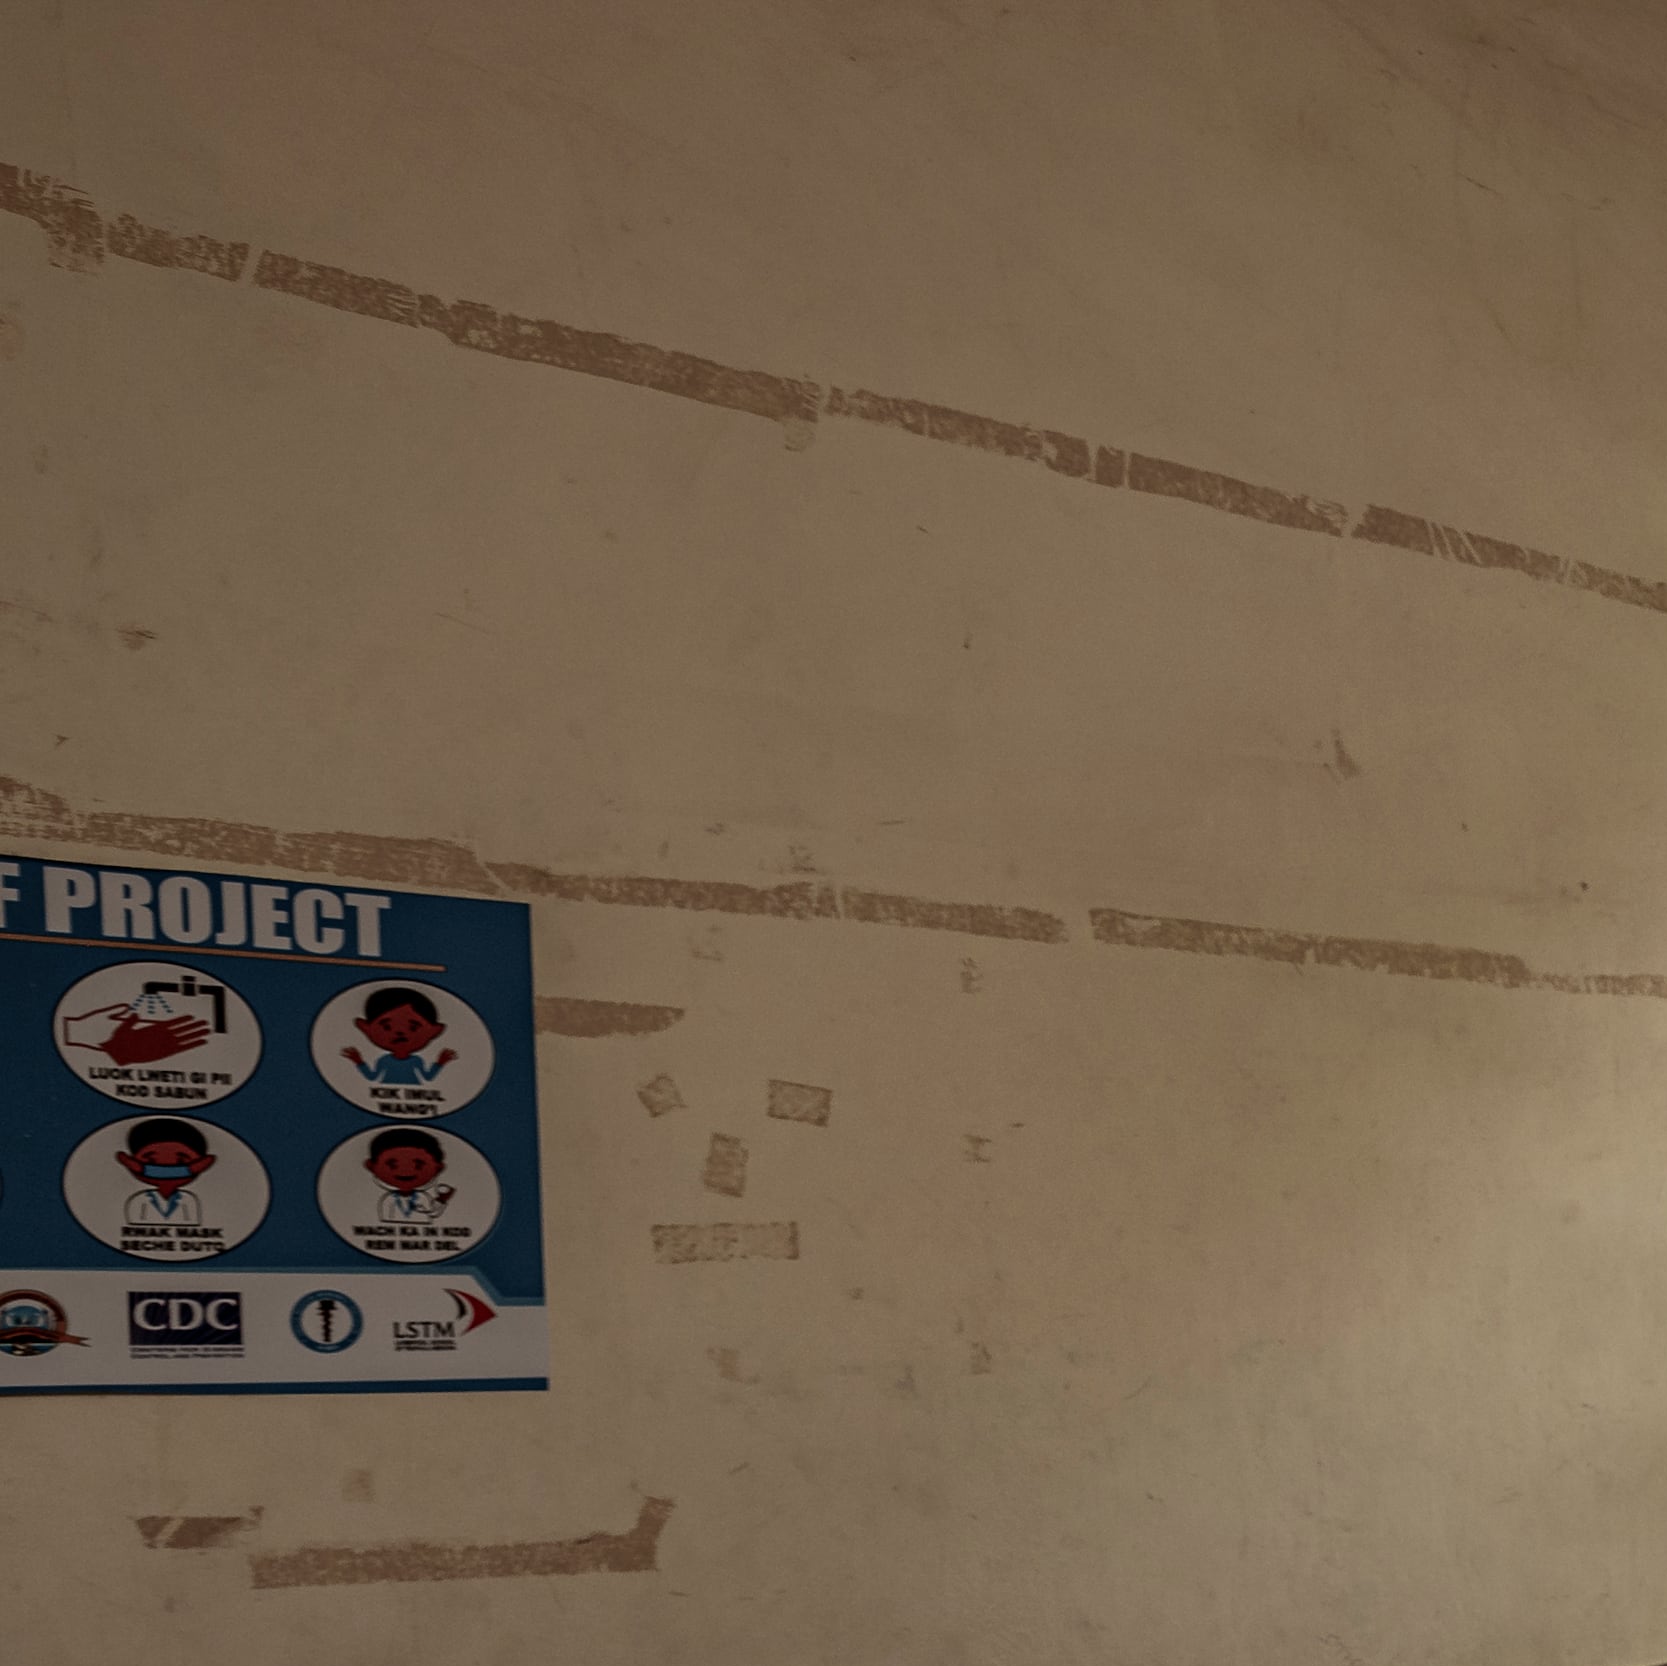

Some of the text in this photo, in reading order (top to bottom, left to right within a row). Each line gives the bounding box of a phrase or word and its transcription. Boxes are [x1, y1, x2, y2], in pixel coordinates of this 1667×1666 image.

[43, 865, 392, 958] PROJECT
[154, 1086, 208, 1100] SABUN
[176, 1228, 224, 1239] MASK
[133, 1297, 239, 1331] CDC
[392, 1321, 458, 1340] LSTM
